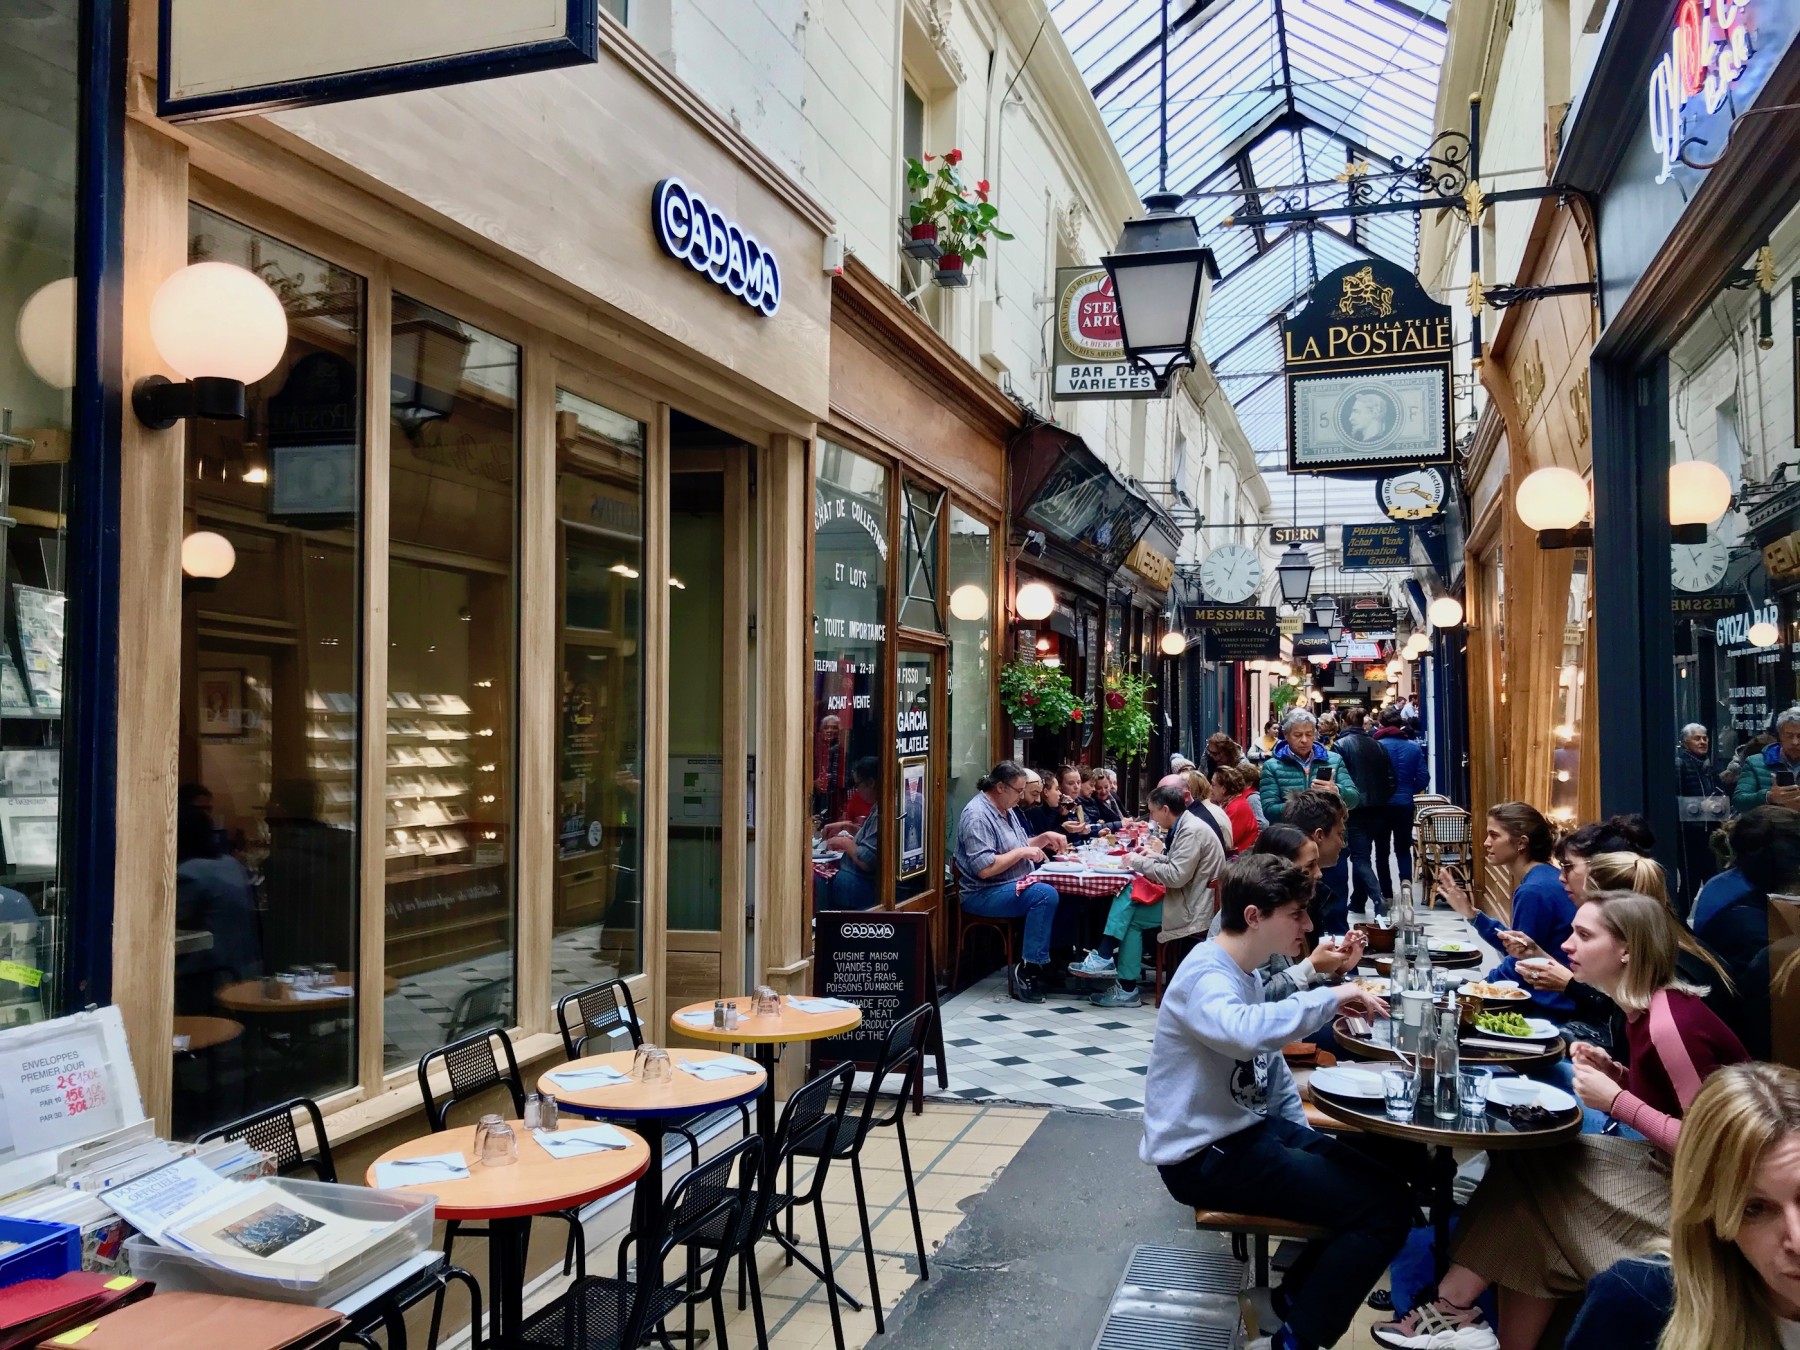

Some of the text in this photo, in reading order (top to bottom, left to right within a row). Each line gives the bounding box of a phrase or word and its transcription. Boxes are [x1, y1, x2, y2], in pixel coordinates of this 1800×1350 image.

[656, 178, 781, 316] CADAMA
[1083, 302, 1118, 315] STE
[1082, 315, 1121, 328] ART
[1352, 316, 1450, 332] PHILATELIE
[1286, 324, 1451, 362] LA POSTALE
[1071, 365, 1148, 377] BAR DES
[1069, 377, 1150, 390] VARIETES
[1319, 406, 1419, 429] 5 F
[815, 501, 832, 532] CHAT
[836, 499, 846, 519] DE
[1407, 509, 1420, 517] 54
[1275, 528, 1319, 542] STERN
[1346, 547, 1397, 557] Estimation
[1368, 556, 1407, 565] Gratuite
[835, 563, 867, 589] ET LOTS
[1195, 609, 1266, 621] MESSMER
[824, 618, 845, 638] TOUTE
[849, 620, 886, 643] IMPORTANCE
[1716, 612, 1750, 647] GYOZA
[828, 695, 847, 711] ACHAT
[853, 694, 871, 710] VENTE
[897, 711, 928, 732] GARCIA
[841, 923, 894, 938] CADAMA
[833, 952, 899, 960] CUISINE MAISON
[836, 962, 889, 972] VIANDES BIO
[834, 973, 897, 982] PRODUITS FRAIS
[826, 980, 904, 993] POISSONS DU MARCHÉ
[877, 999, 900, 1008] FOOD
[870, 1009, 893, 1019] MEAT
[855, 1031, 866, 1040] OF
[867, 1031, 884, 1040] THE
[22, 1050, 79, 1071] ENVELOPPES
[20, 1060, 85, 1083] PREMIER JOUR
[40, 1098, 54, 1107] PAR
[40, 1113, 54, 1122] PAR
[54, 1111, 62, 1119] 30
[113, 1166, 179, 1198] DOCUMENTS
[128, 1176, 181, 1202] OFFICIELS
